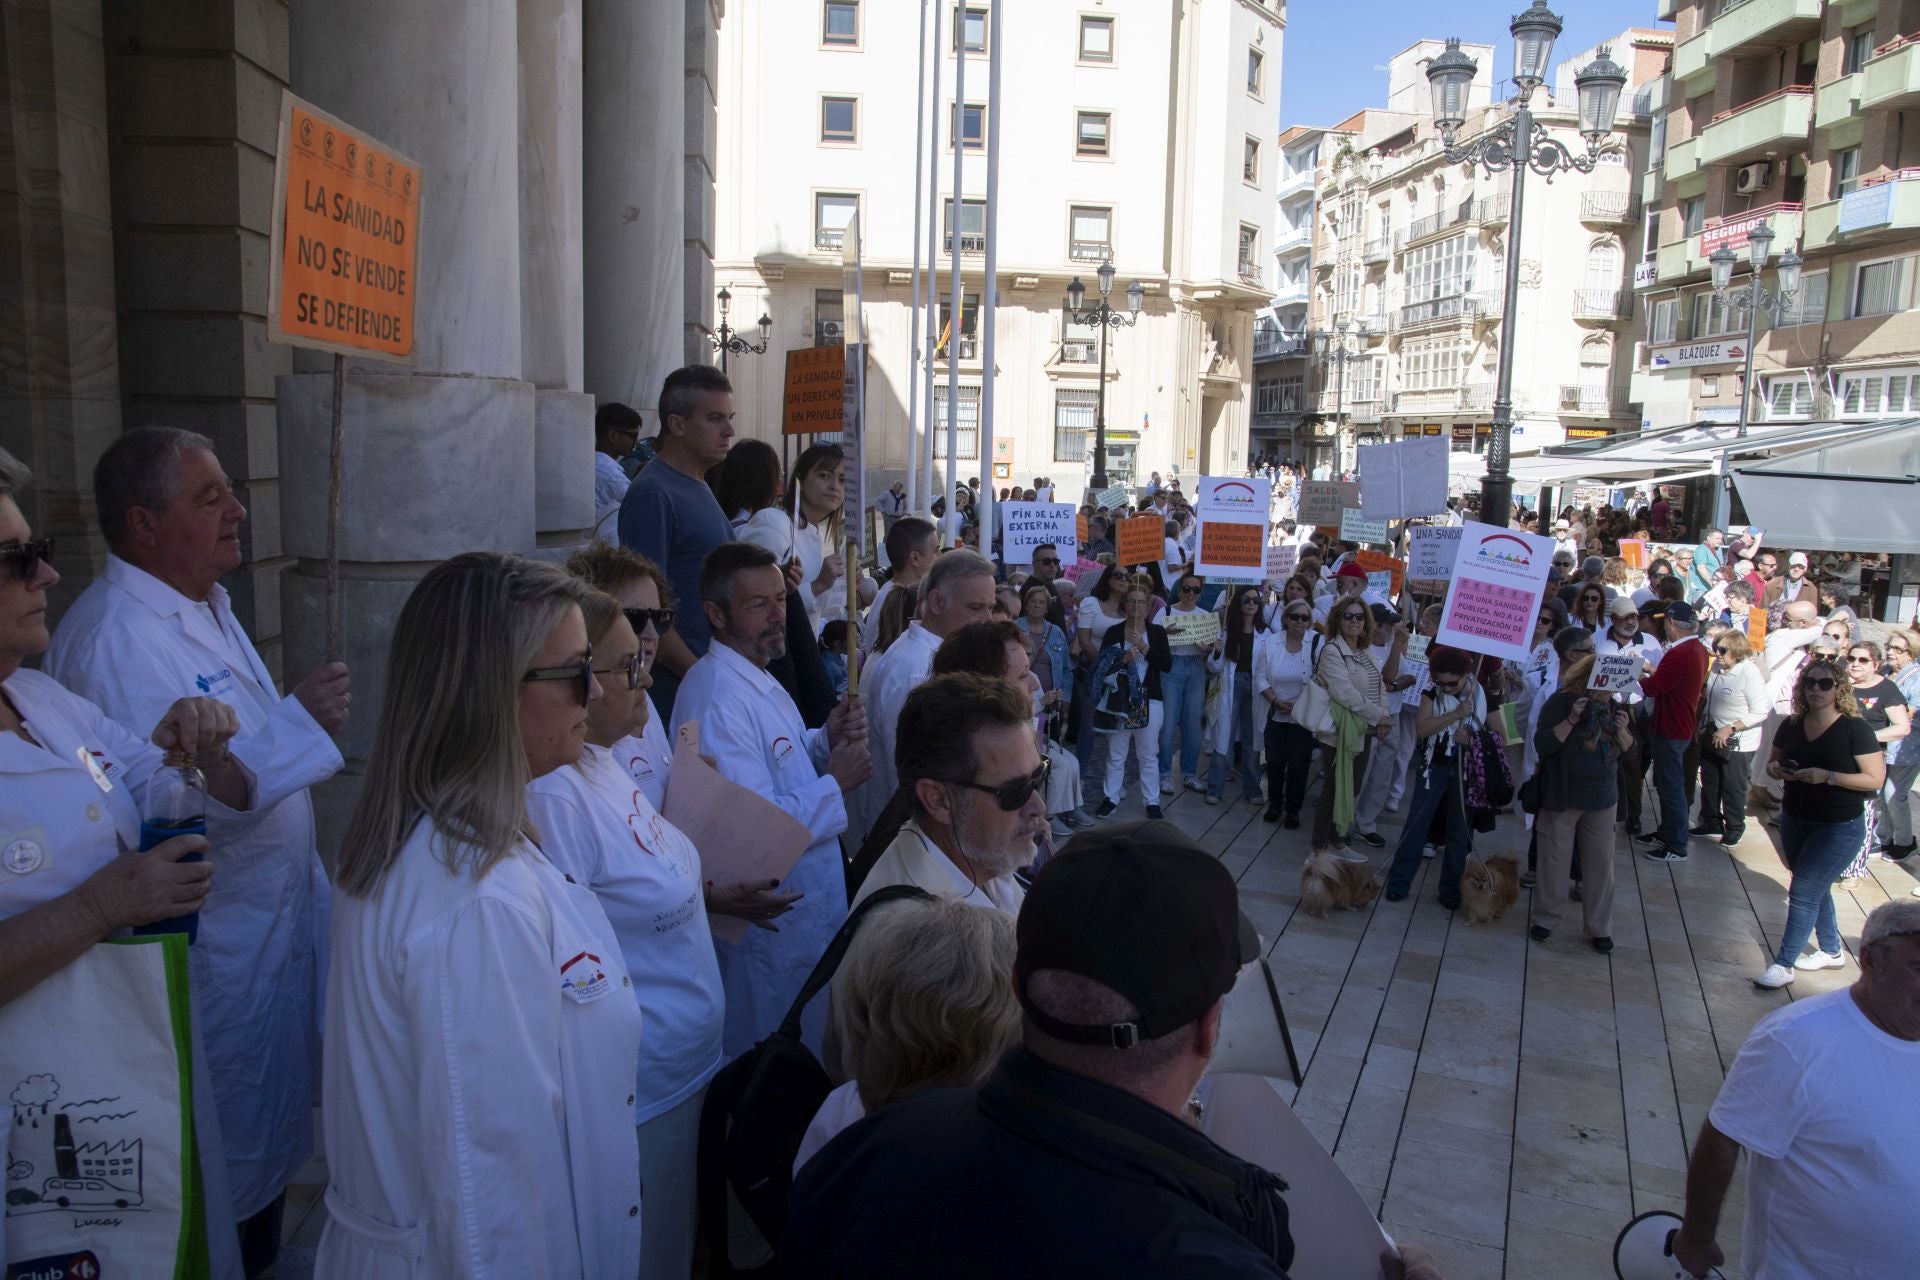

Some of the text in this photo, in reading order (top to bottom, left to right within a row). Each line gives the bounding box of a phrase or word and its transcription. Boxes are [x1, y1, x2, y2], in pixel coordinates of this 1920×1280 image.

[304, 180, 405, 245] LA SANIDAD
[298, 235, 406, 295] NO SE VENDE
[297, 293, 401, 343] SE DEFIENDE
[1679, 344, 1720, 360] BLÁZQUEZ
[792, 370, 842, 384] LA SANIDAD
[788, 389, 840, 404] UN DERECHO
[792, 411, 804, 422] UN
[1306, 486, 1338, 495] SALUD
[1035, 510, 1047, 518] DE
[1050, 510, 1070, 519] LAS
[1008, 521, 1058, 531] EXTERNA
[1416, 528, 1433, 539] UNA
[1014, 534, 1075, 546] LIZACIONES
[1458, 592, 1528, 613] POR UNA SANIDAD
[1454, 612, 1511, 630] PRIVATIZACIÓN
[1493, 610, 1506, 619] NO
[1514, 614, 1524, 622] LA
[1459, 624, 1512, 641] LOS SERVICIOS
[1601, 656, 1633, 665] SANIDAD
[1593, 674, 1609, 687] NO
[74, 1218, 123, 1229] Lucas
[17, 1268, 64, 1280] Club
